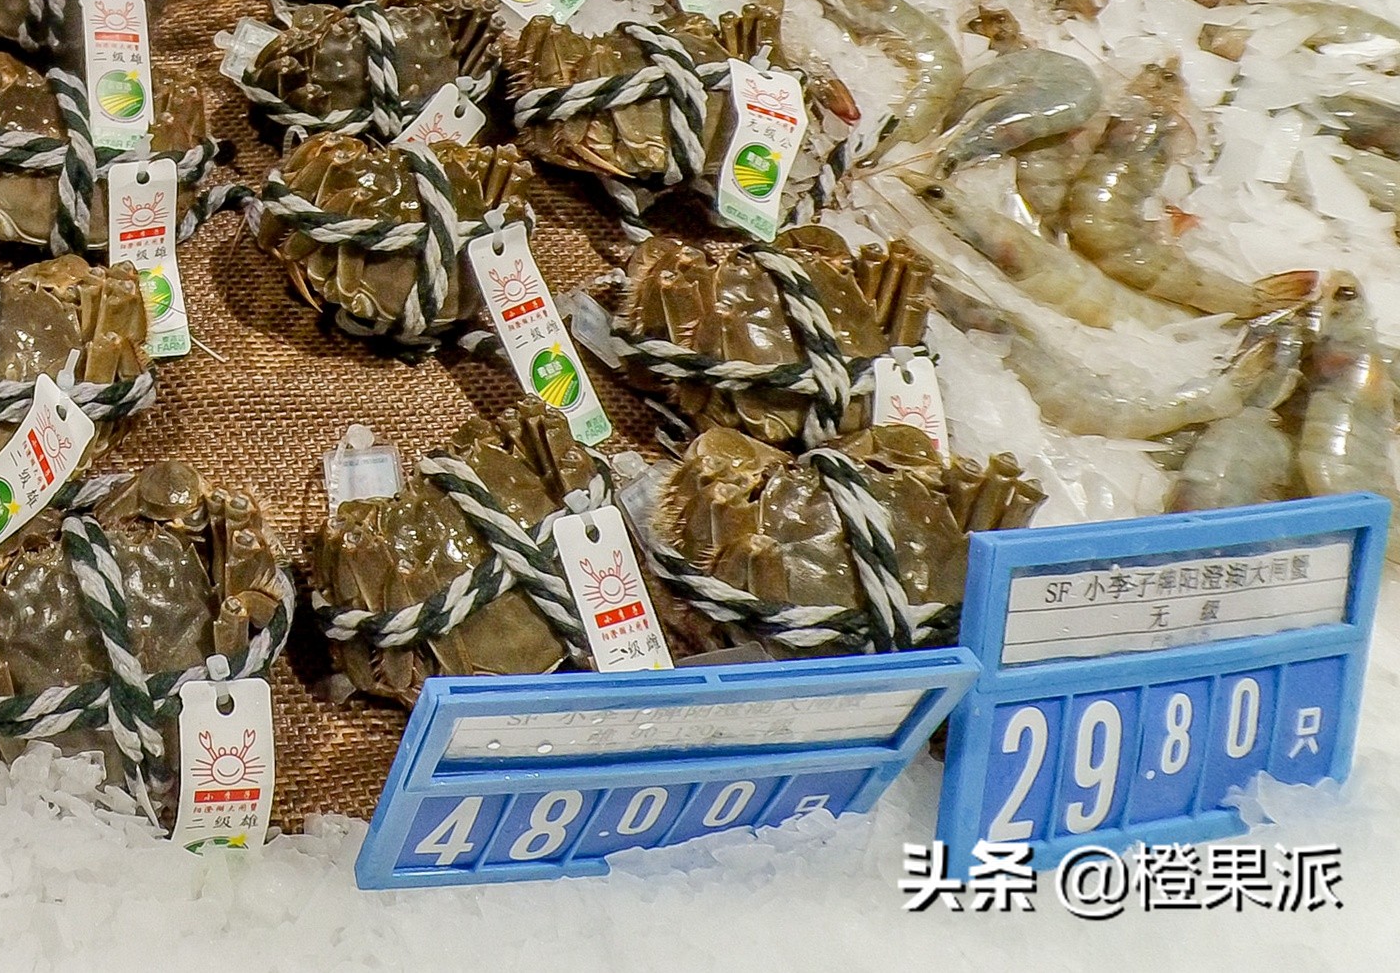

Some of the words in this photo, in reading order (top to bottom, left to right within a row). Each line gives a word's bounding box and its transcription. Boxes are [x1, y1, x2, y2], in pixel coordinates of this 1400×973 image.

[1045, 581, 1072, 603] SF
[987, 677, 1261, 843] 29.80
[1288, 707, 1322, 759] 只
[185, 814, 259, 829] 二级雄
[415, 779, 758, 866] 48.00
